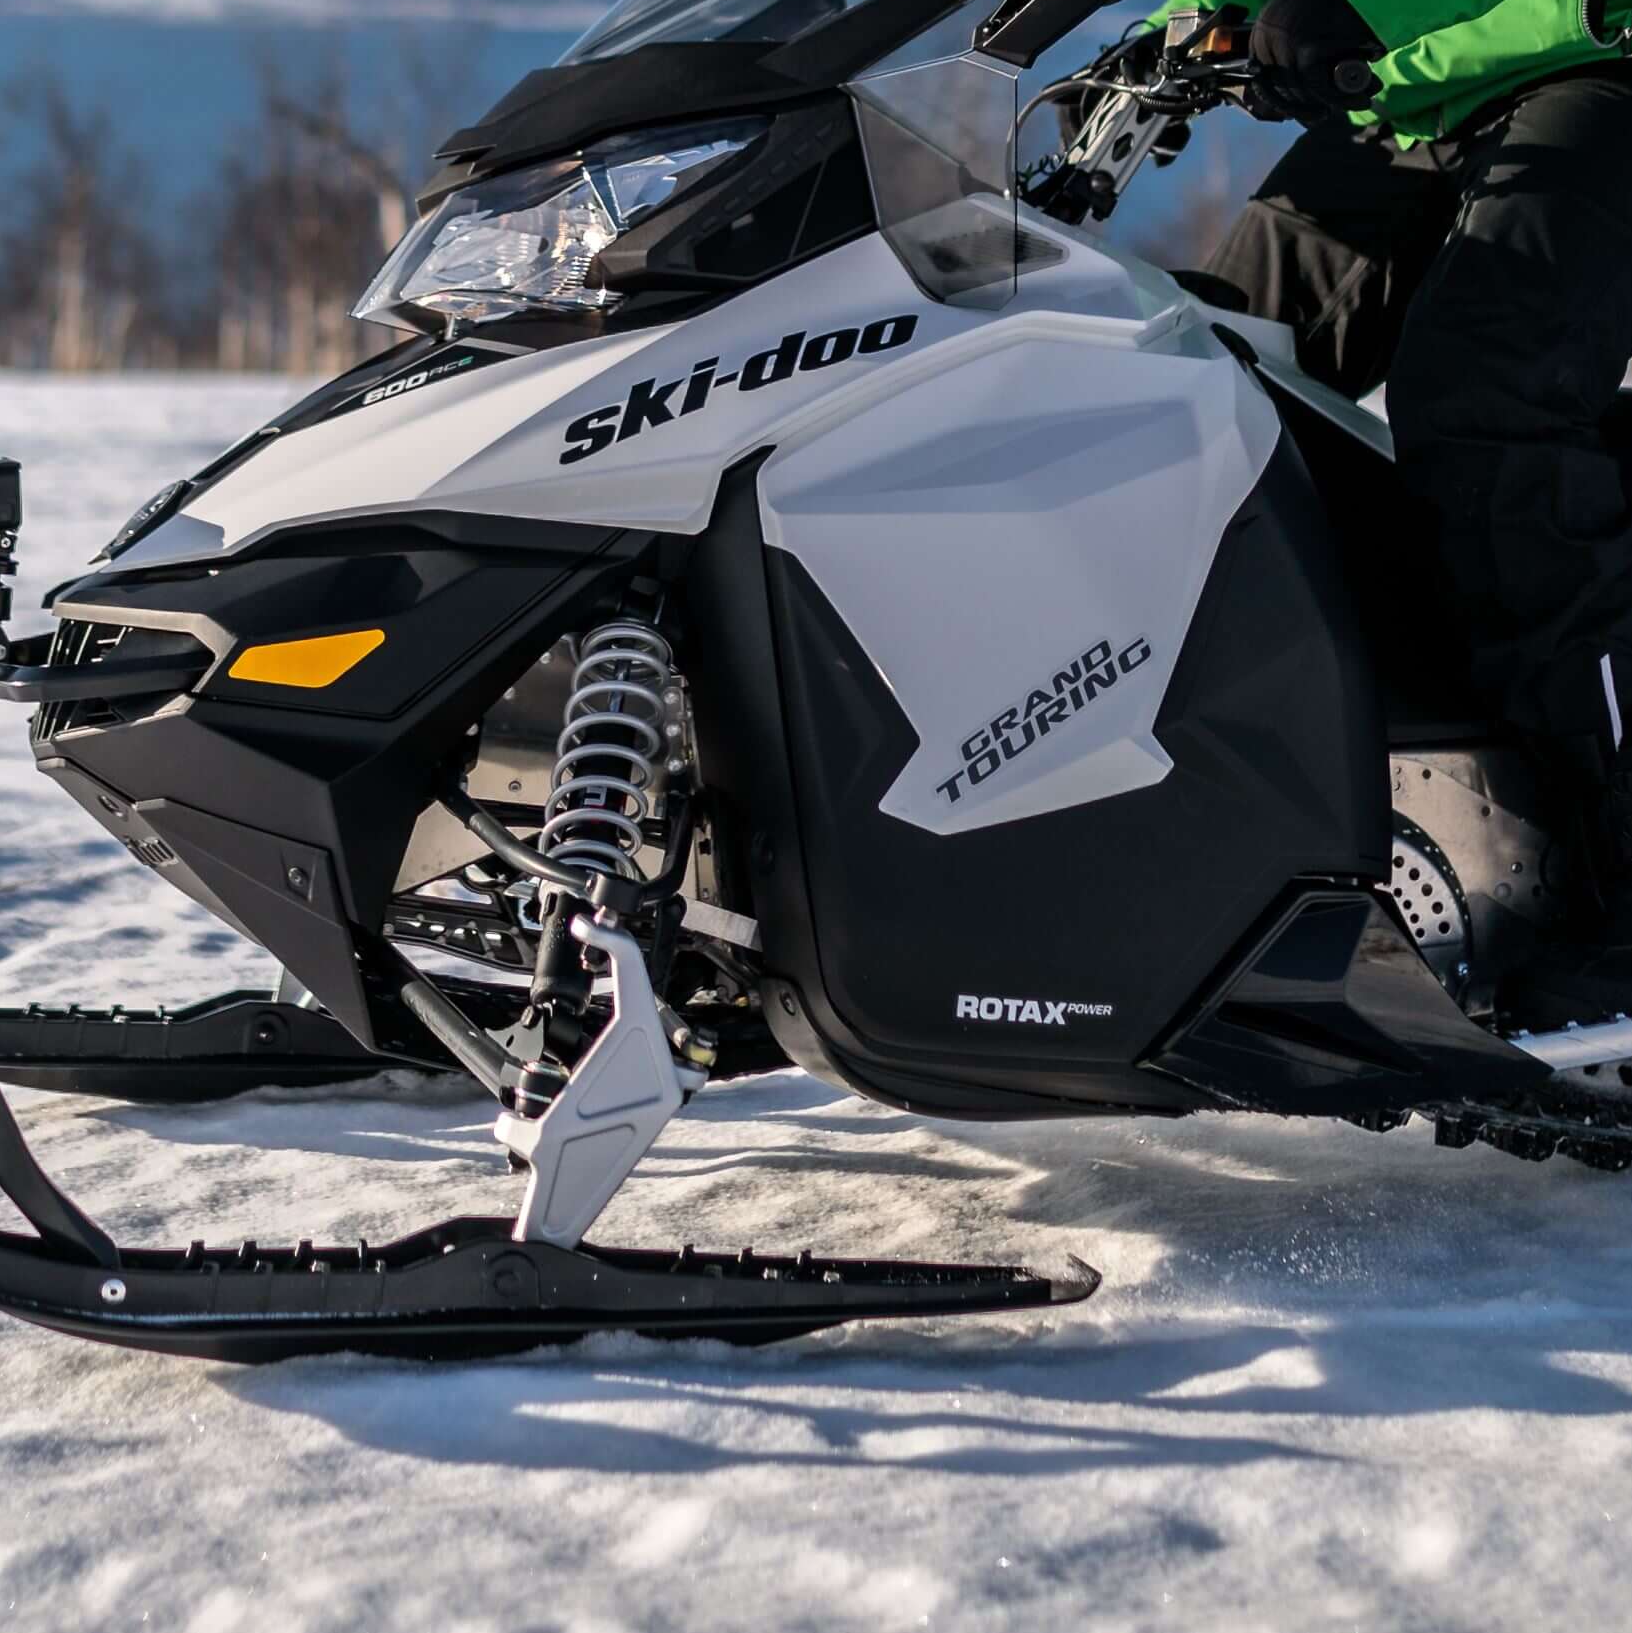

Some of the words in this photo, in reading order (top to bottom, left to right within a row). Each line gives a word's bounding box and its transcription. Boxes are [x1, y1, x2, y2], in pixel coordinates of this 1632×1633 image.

[362, 371, 428, 405] 600
[428, 355, 474, 377] ACE
[935, 636, 1152, 804] TOURING
[961, 639, 1112, 762] GRAND
[956, 994, 1068, 1026] ROTAX
[1067, 1002, 1114, 1016] POWER
